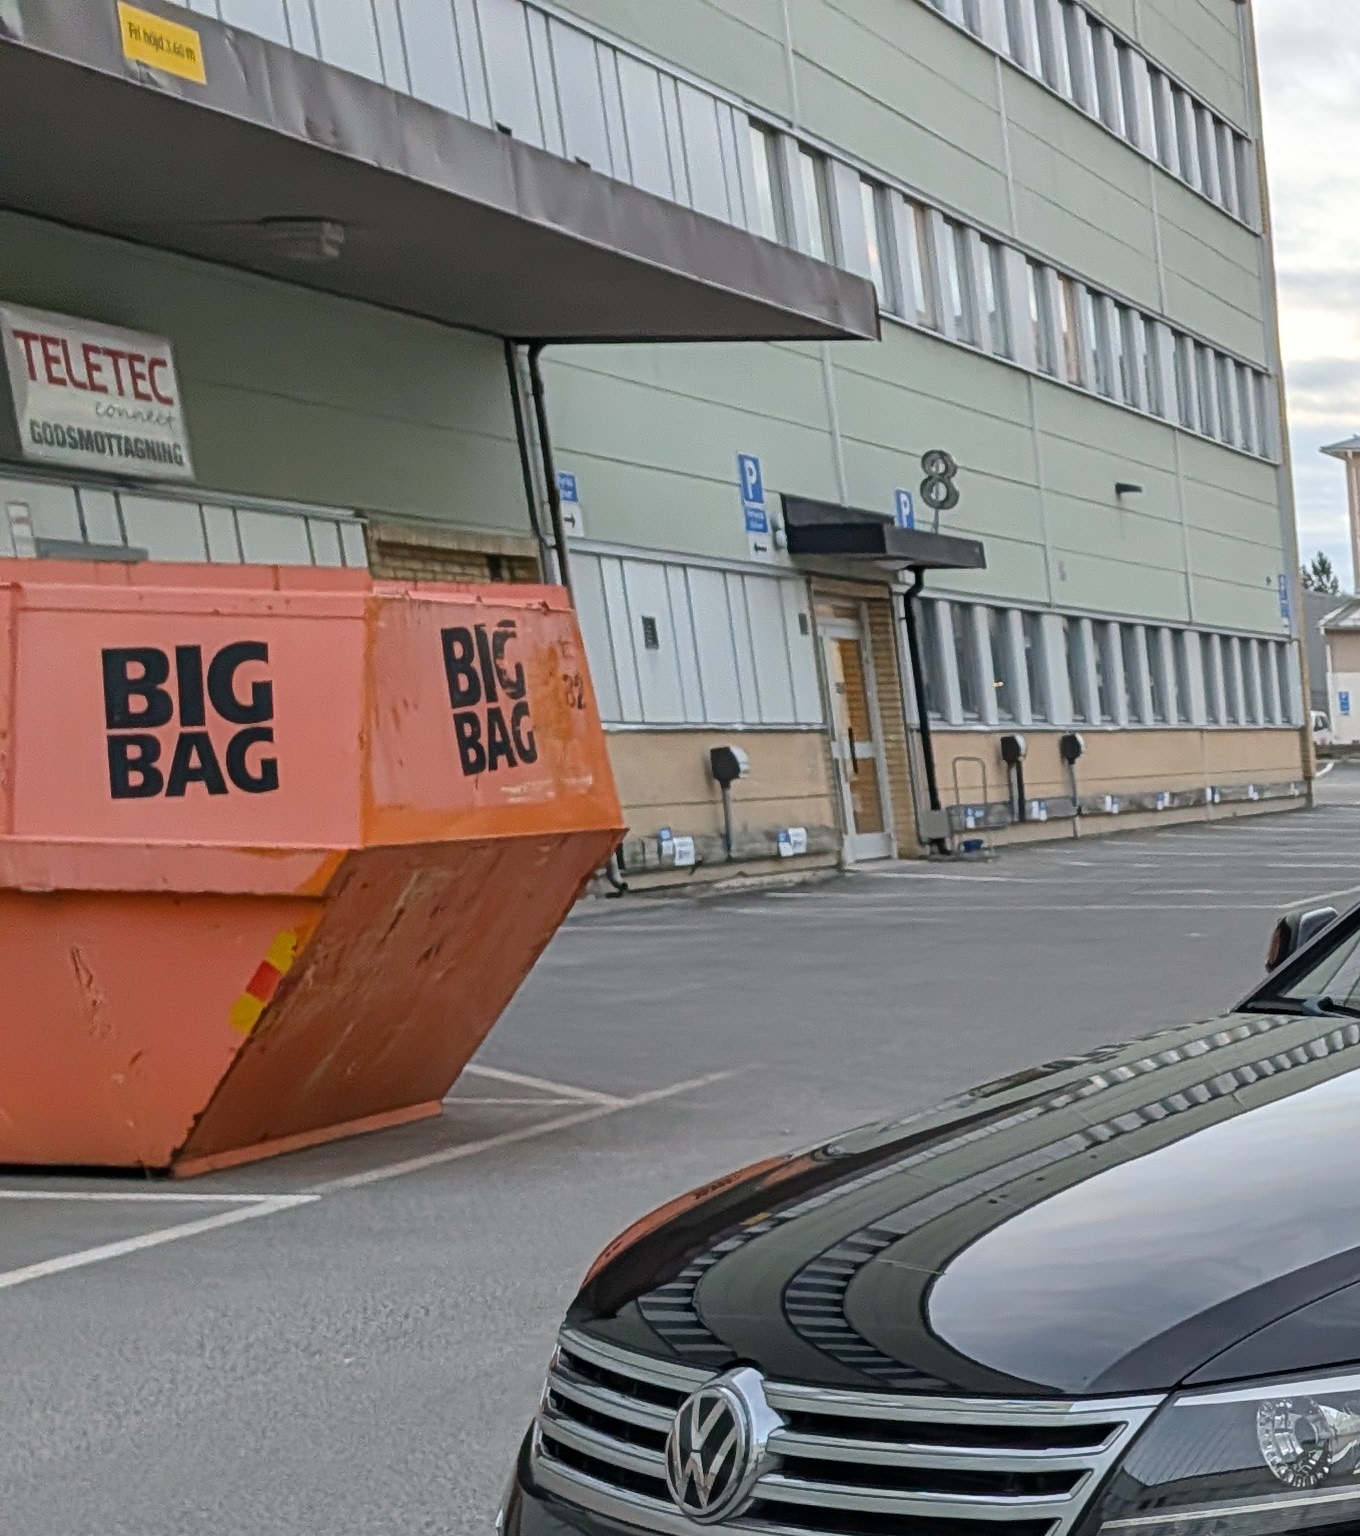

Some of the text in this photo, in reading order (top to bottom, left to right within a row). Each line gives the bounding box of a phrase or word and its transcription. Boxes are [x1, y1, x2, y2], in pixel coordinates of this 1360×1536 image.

[12, 328, 174, 406] TELETEC
[28, 418, 186, 467] GODSMOTTAGNING
[743, 458, 758, 500] P
[900, 492, 911, 528] P
[920, 449, 960, 511] 8
[101, 640, 274, 730] BIG
[440, 618, 527, 710] BIG
[106, 726, 280, 800] BAG
[453, 700, 539, 777] BAG
